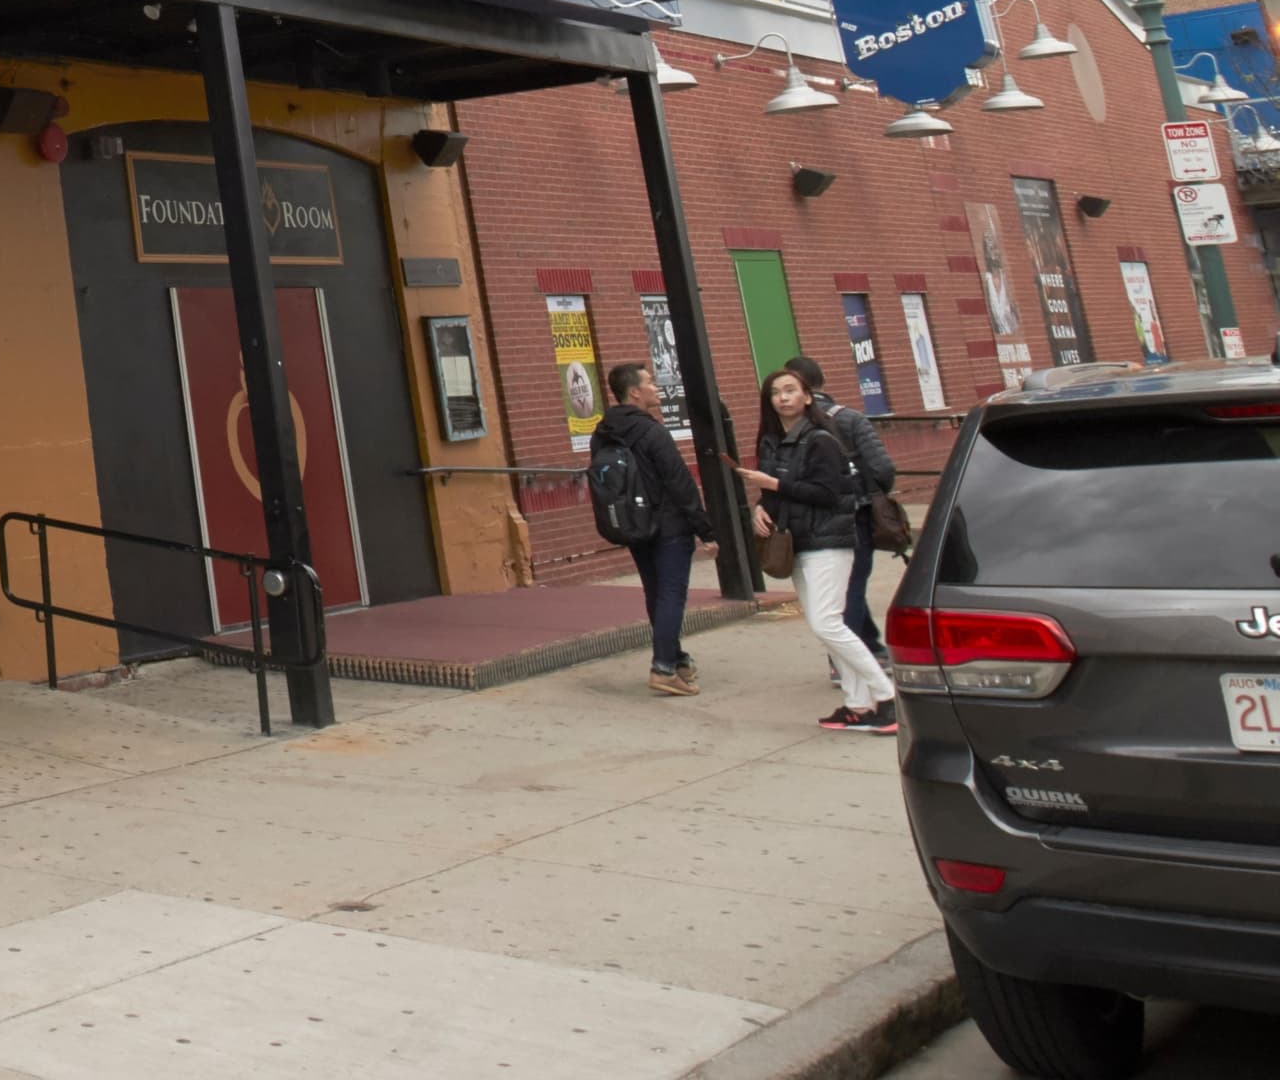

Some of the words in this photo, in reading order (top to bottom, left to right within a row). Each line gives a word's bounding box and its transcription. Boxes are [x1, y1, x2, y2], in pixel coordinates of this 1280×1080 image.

[854, 1, 966, 60] Boston
[1167, 127, 1185, 137] TOW
[1186, 126, 1206, 136] ZONE
[139, 194, 224, 225] FOUNDAT
[281, 201, 335, 230] ROOM
[1048, 300, 1068, 313] GOOD
[1061, 350, 1080, 364] LIVES
[991, 754, 1064, 771] 4x4
[1005, 787, 1085, 806] QUIRK
